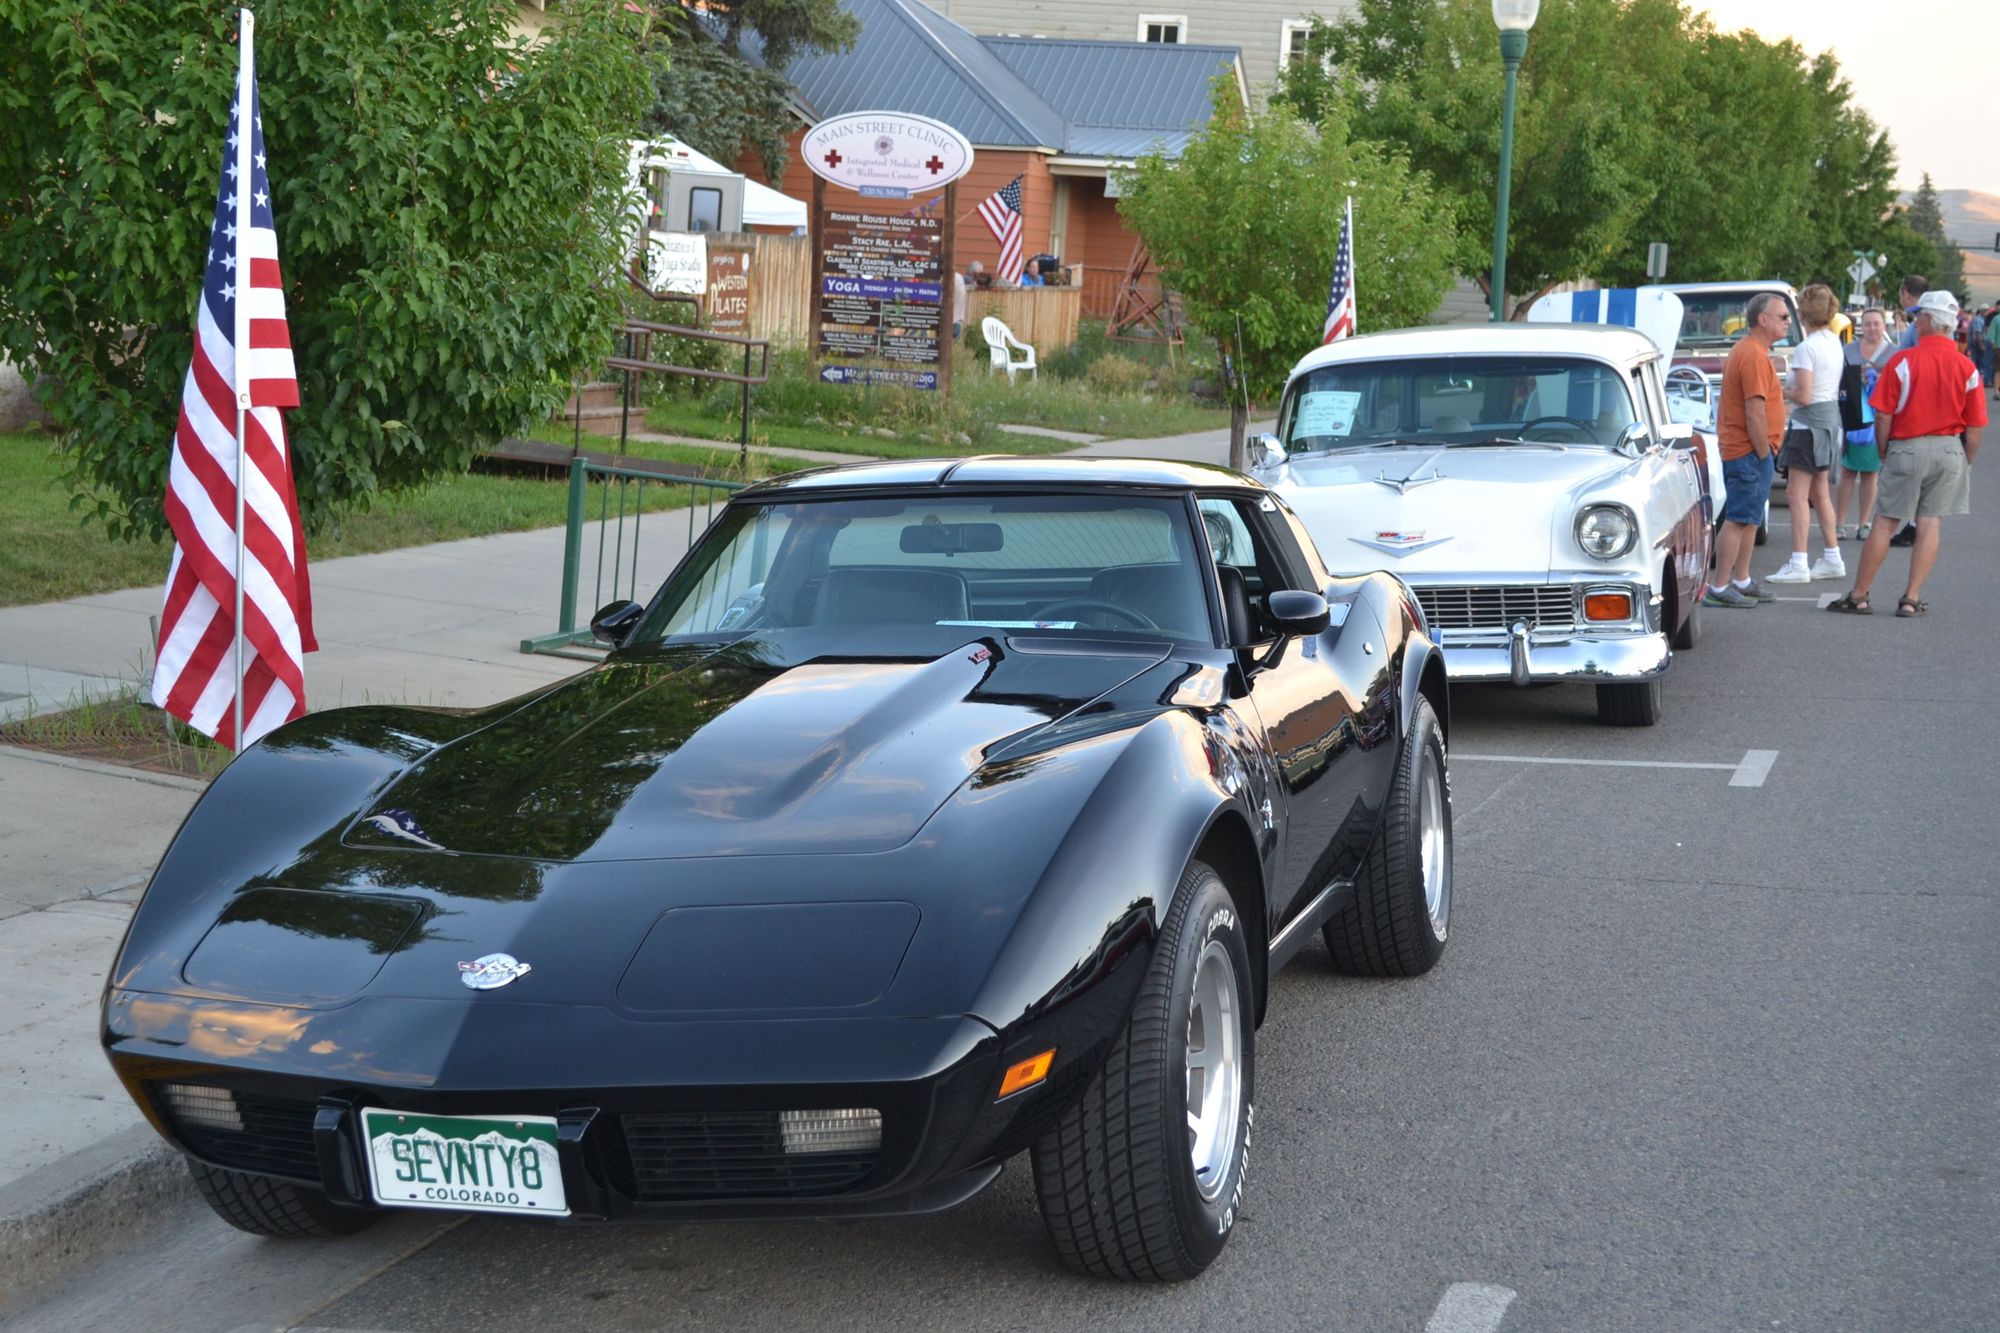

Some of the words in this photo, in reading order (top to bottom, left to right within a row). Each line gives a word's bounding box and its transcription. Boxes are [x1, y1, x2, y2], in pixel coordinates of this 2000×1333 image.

[815, 124, 854, 148] MAIN
[856, 121, 905, 136] STREET
[907, 126, 954, 154] CLINIC
[846, 156, 887, 168] Integrated
[889, 158, 921, 170] Medical
[856, 169, 890, 179] Wellness
[891, 170, 919, 181] Center
[886, 188, 905, 197] Main
[830, 212, 860, 223] ROANNE
[862, 214, 888, 225] ROUSE
[889, 217, 918, 227] HOUCK,
[919, 219, 938, 228] N.D.
[852, 237, 874, 246] STACY
[875, 238, 892, 247] RAE,
[826, 256, 853, 264] CLAUDIA
[897, 260, 913, 269] LPC,
[914, 261, 929, 270] CAC
[859, 264, 889, 273] CERTIFIED
[889, 266, 924, 275] COUNSELOR
[716, 270, 748, 292] WESTERN
[827, 279, 861, 293] YOGA
[863, 284, 888, 293] IYENGAR
[918, 288, 938, 297] HATHA
[710, 282, 747, 315] PILATES
[1207, 908, 1235, 938] COBRA
[391, 1138, 543, 1191] SEVNTY8
[1232, 1102, 1254, 1209] RADIAL
[425, 1186, 520, 1205] COLORADO
